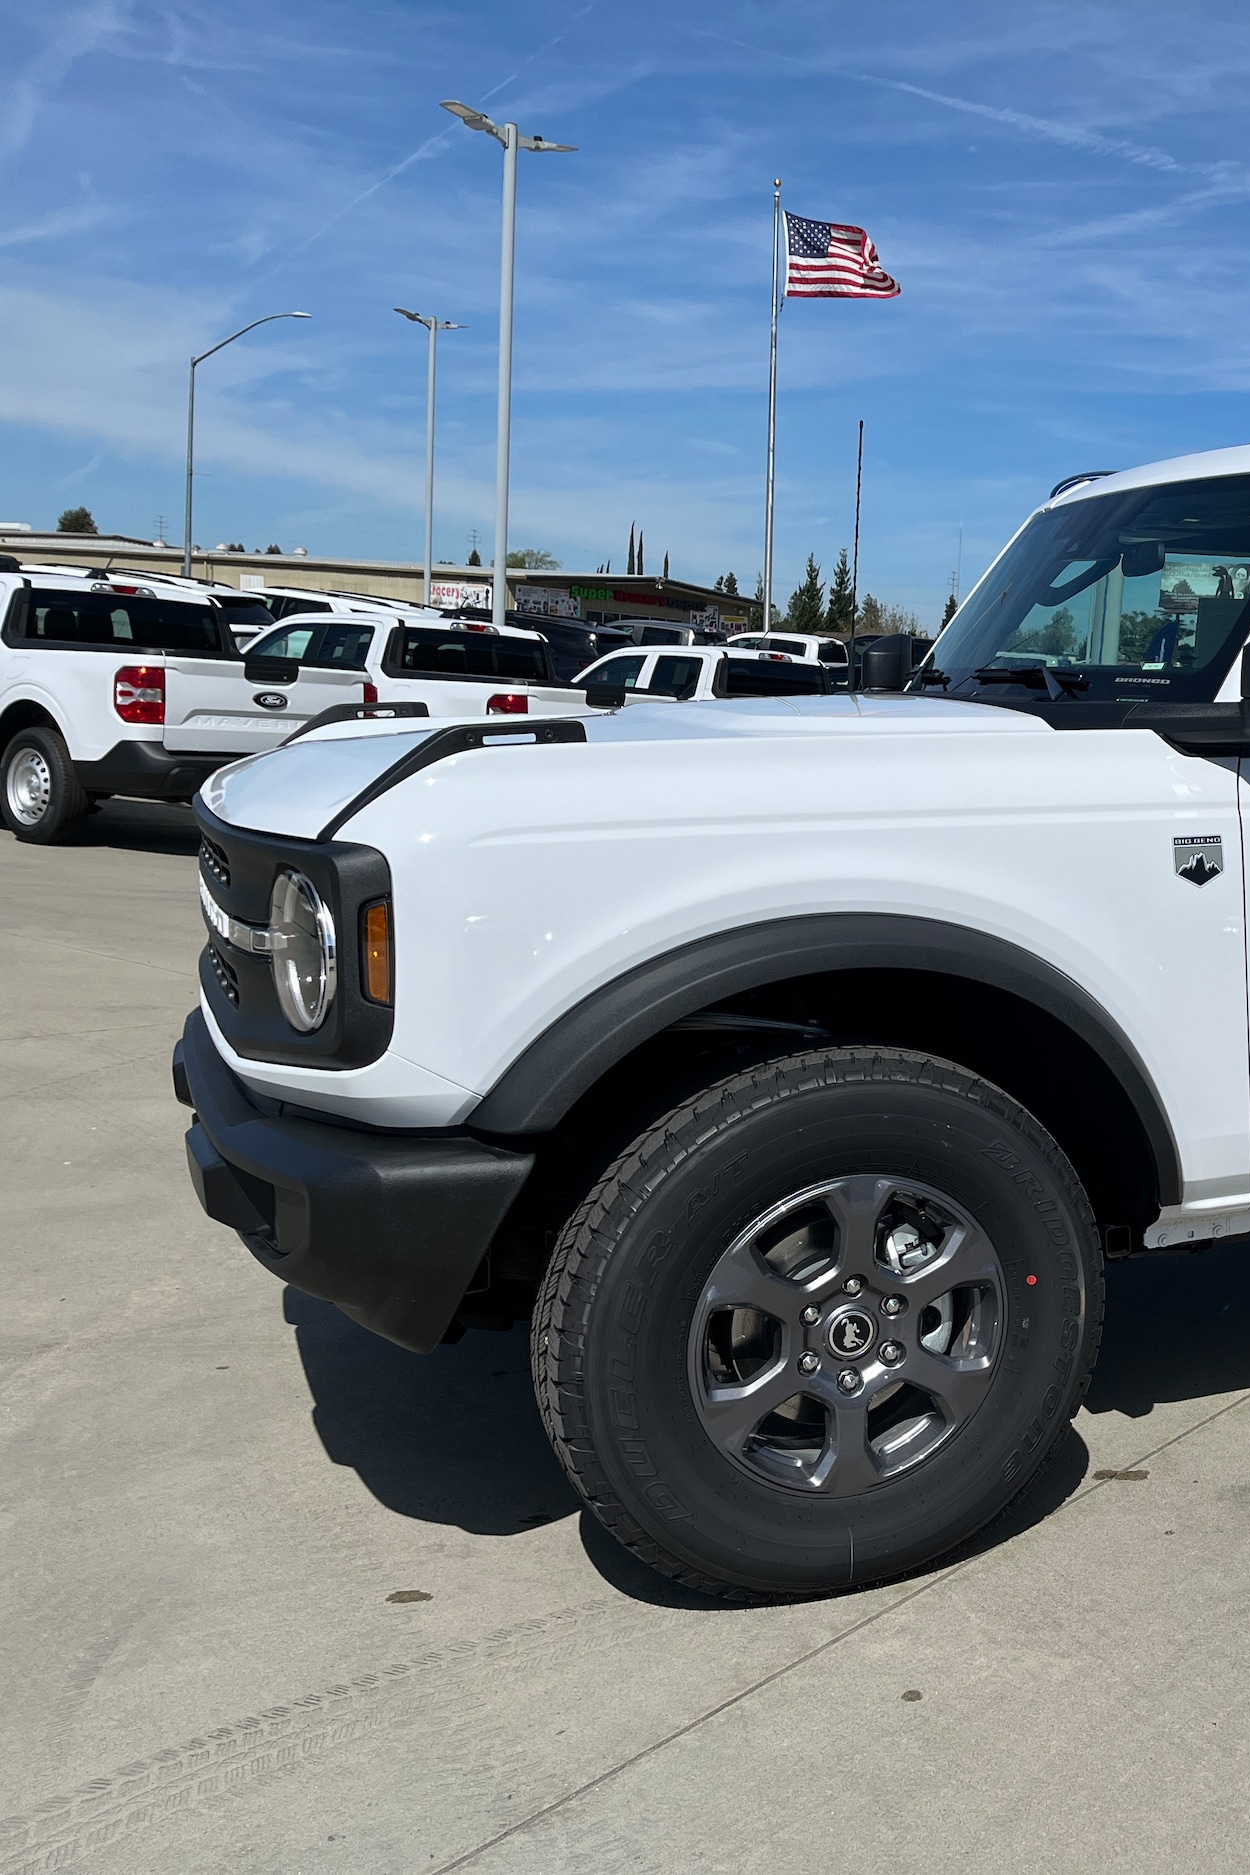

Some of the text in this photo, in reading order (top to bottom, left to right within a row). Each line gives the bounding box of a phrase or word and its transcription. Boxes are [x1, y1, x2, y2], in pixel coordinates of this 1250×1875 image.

[432, 586, 460, 600] rocery
[571, 585, 613, 600] Super
[1115, 677, 1171, 685] BRONCO
[195, 716, 302, 730] MAVERI
[982, 1137, 1081, 1484] BRIDGESTONE
[609, 1227, 696, 1523] DUELER
[686, 1150, 749, 1224] A/T
